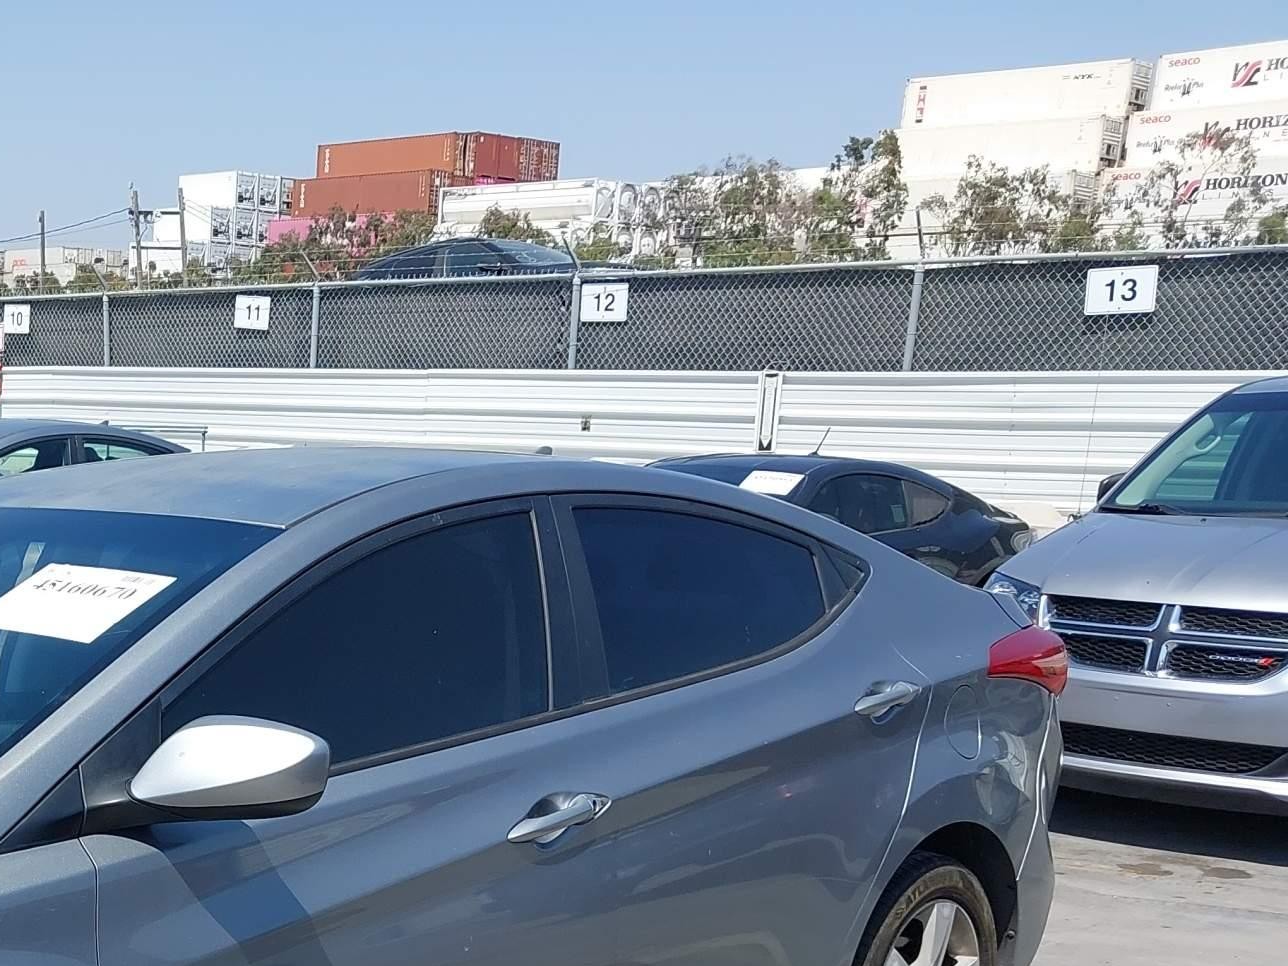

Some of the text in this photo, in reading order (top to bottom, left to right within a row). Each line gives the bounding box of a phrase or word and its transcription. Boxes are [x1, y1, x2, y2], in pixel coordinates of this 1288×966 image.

[1168, 57, 1200, 68] seaco
[1139, 114, 1171, 125] seaco
[1111, 172, 1141, 182] seaco
[1105, 278, 1138, 302] 13
[593, 293, 615, 312] 12
[11, 311, 23, 327] 10
[245, 304, 260, 321] 11
